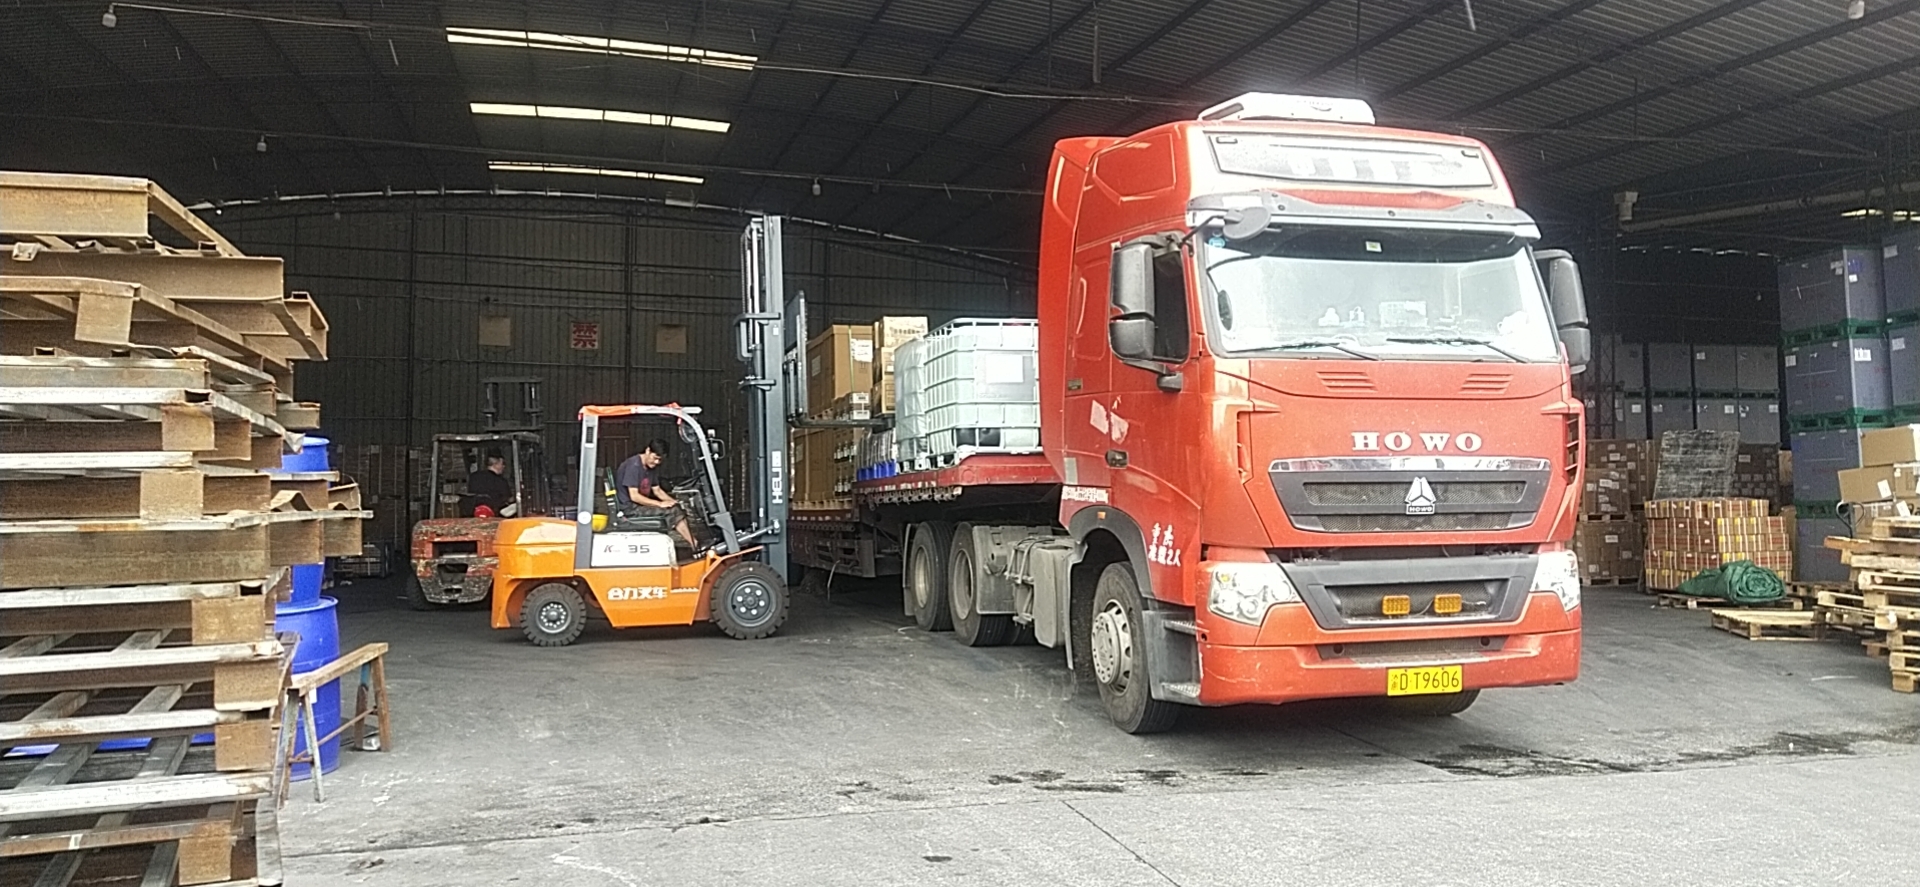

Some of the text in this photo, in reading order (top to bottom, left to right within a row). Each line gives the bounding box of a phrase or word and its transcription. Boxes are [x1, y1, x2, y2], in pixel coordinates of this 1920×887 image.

[1351, 431, 1482, 452] HOWO
[628, 544, 650, 553] 35
[607, 586, 668, 601] 合力叉车
